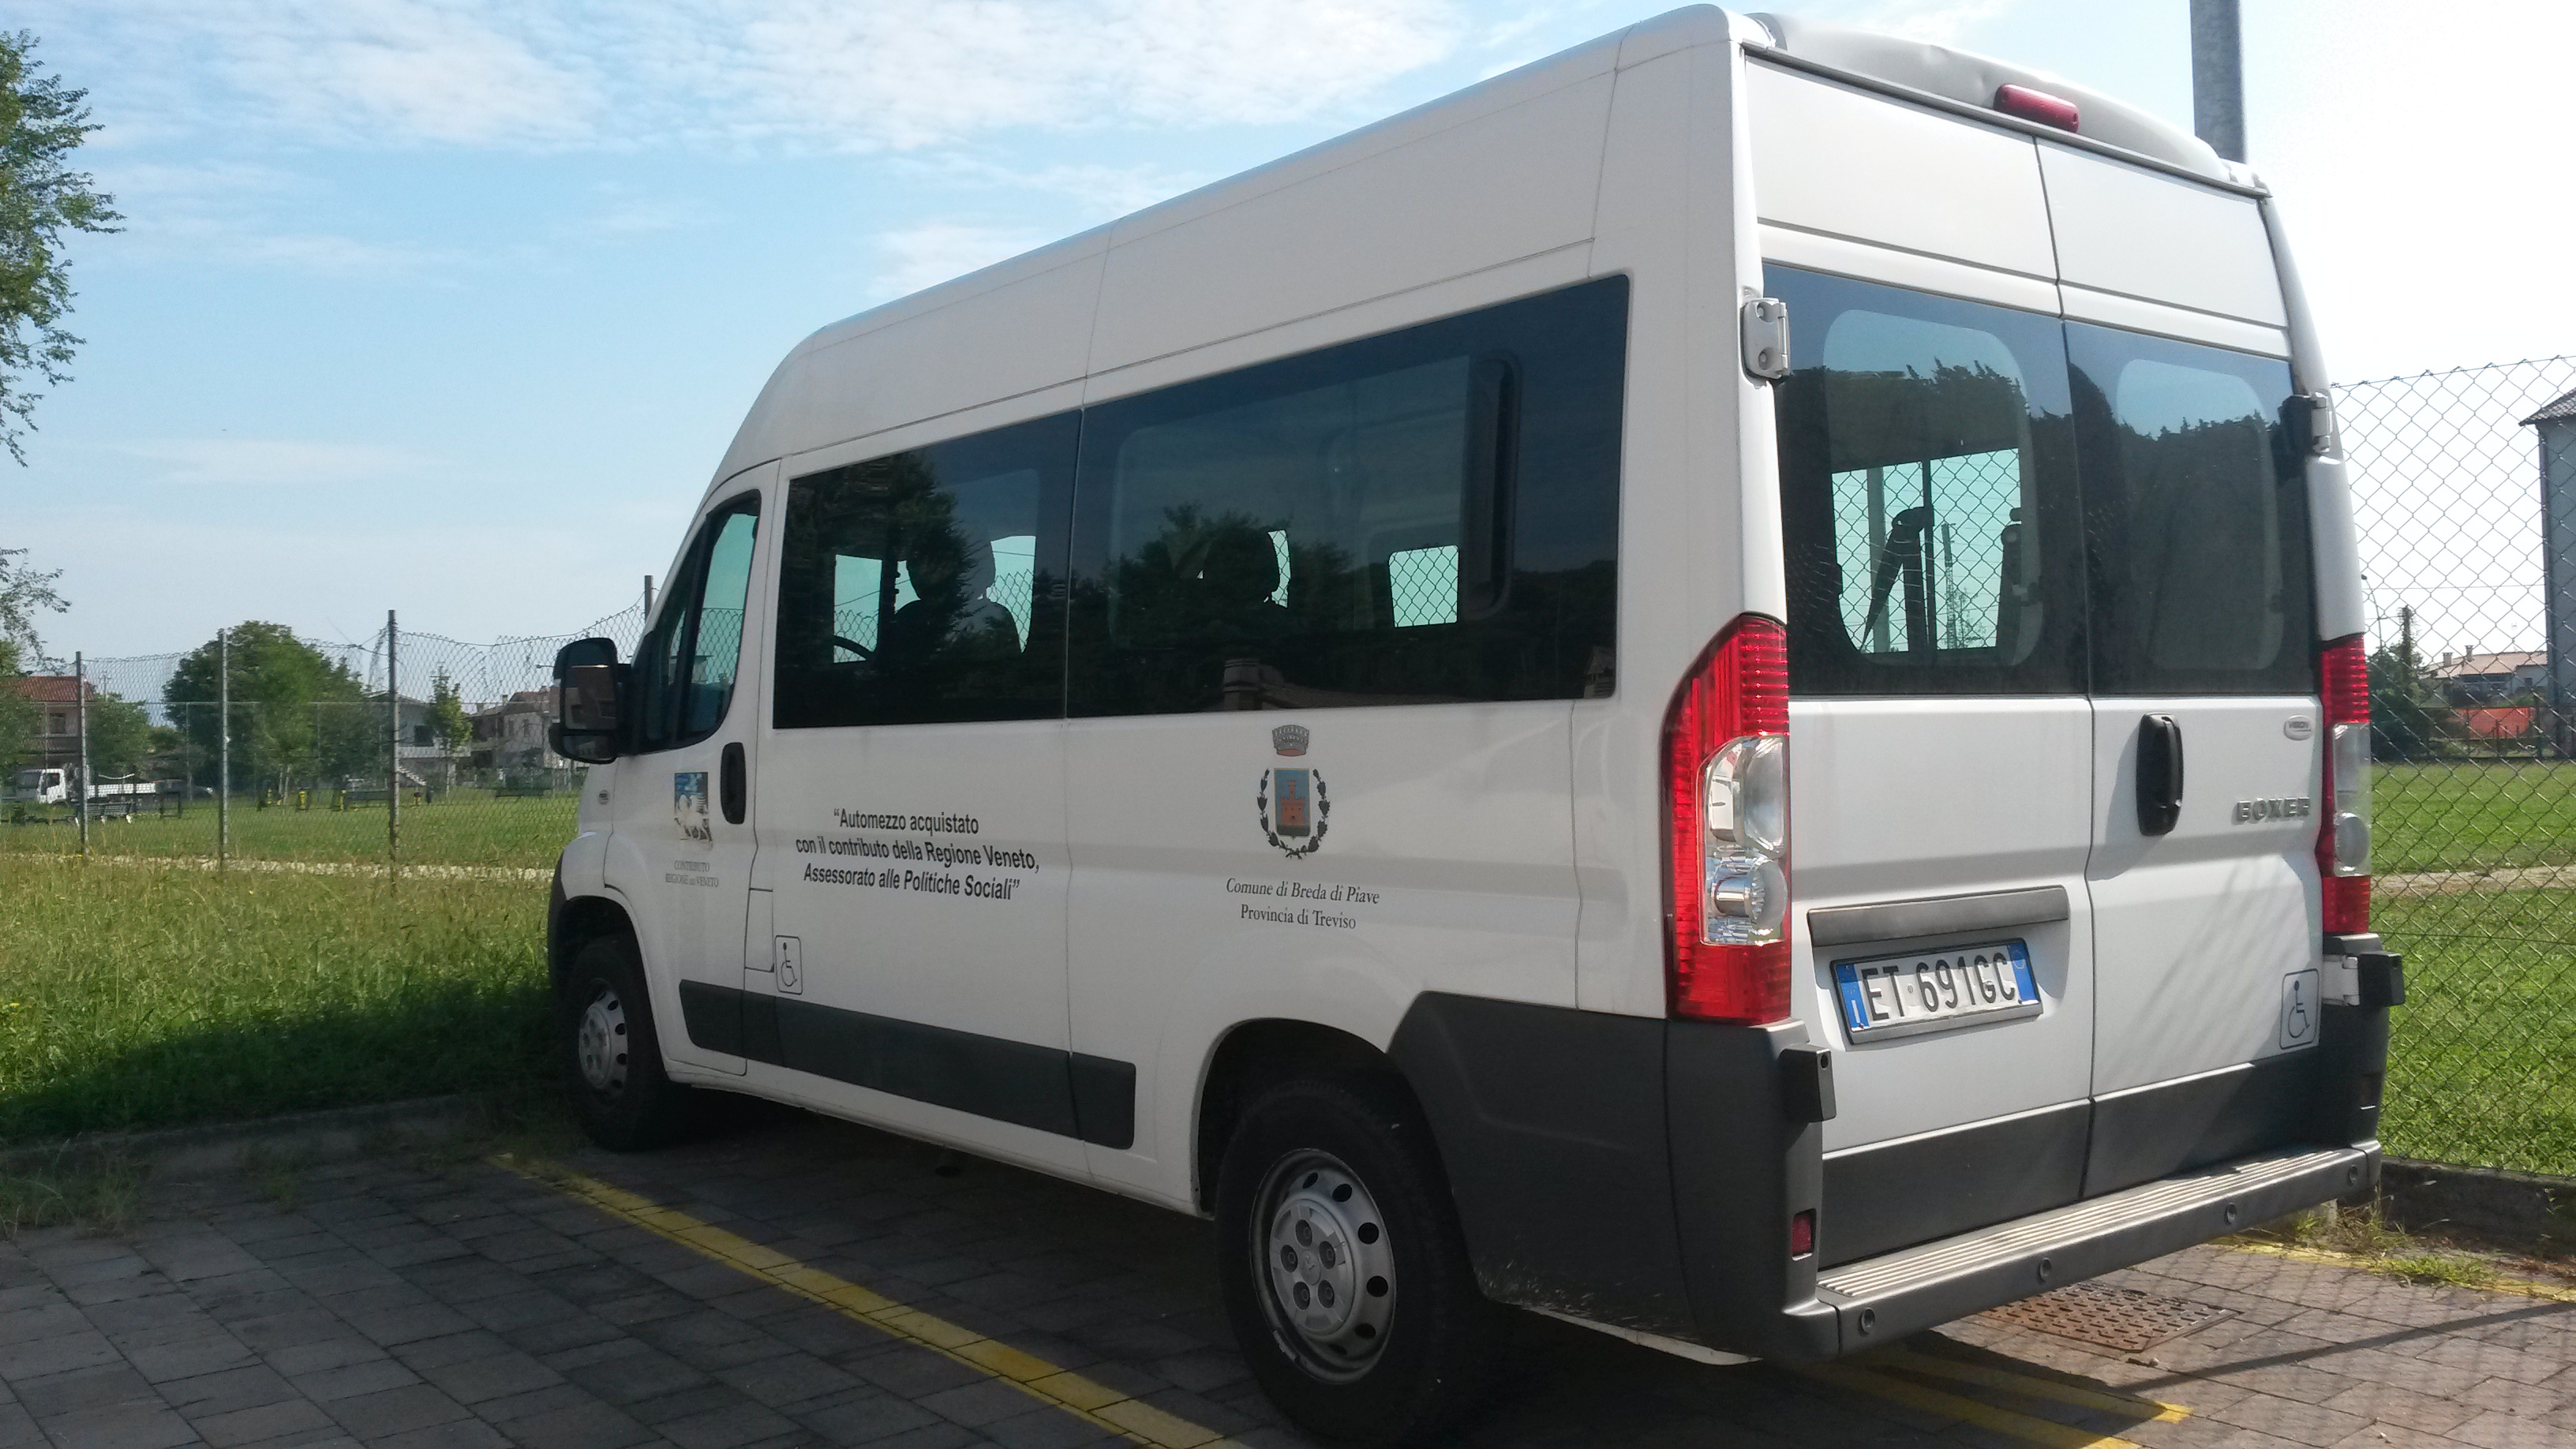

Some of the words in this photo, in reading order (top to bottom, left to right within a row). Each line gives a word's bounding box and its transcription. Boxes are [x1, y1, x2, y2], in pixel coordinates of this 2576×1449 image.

[834, 808, 906, 830] “Automezzo
[910, 811, 979, 837] acquistato
[796, 839, 817, 853] con
[818, 836, 826, 854] il
[829, 837, 889, 858] contributo
[893, 840, 923, 860] della
[924, 841, 981, 868] Regione
[983, 844, 1039, 874] Veneto,
[803, 863, 875, 887] Assessorato
[878, 869, 900, 889] alle
[904, 870, 960, 895] Politiche
[964, 874, 1020, 900] Sociali”
[1226, 878, 1273, 895] Comune
[1276, 881, 1289, 897] di
[1291, 882, 1327, 900] Breda
[1330, 885, 1343, 901] di
[1346, 886, 1380, 904] Piave
[1241, 904, 1294, 923] Provincia
[1297, 908, 1309, 925] di
[1312, 909, 1357, 929] Treviso
